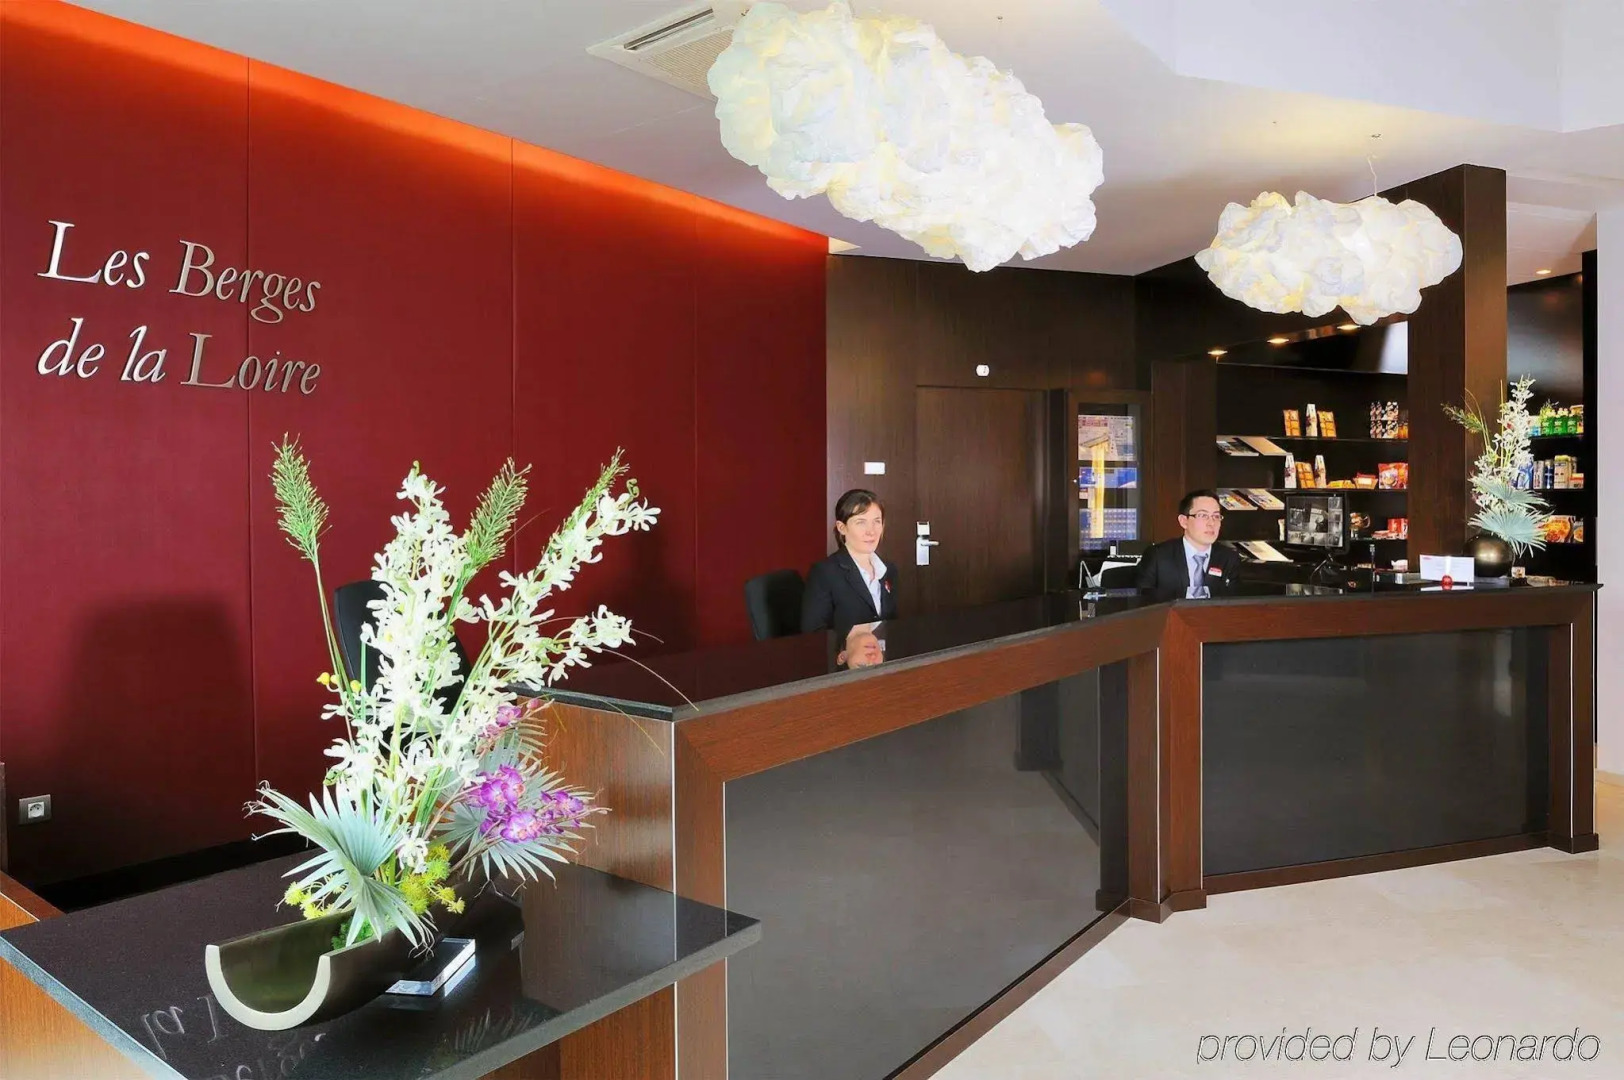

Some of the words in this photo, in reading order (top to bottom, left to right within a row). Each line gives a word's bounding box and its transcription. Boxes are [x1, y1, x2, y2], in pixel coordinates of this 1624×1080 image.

[37, 220, 150, 289] Les
[168, 239, 321, 324] Berges
[37, 317, 105, 379] de
[120, 325, 167, 383] la
[180, 332, 321, 395] Loire
